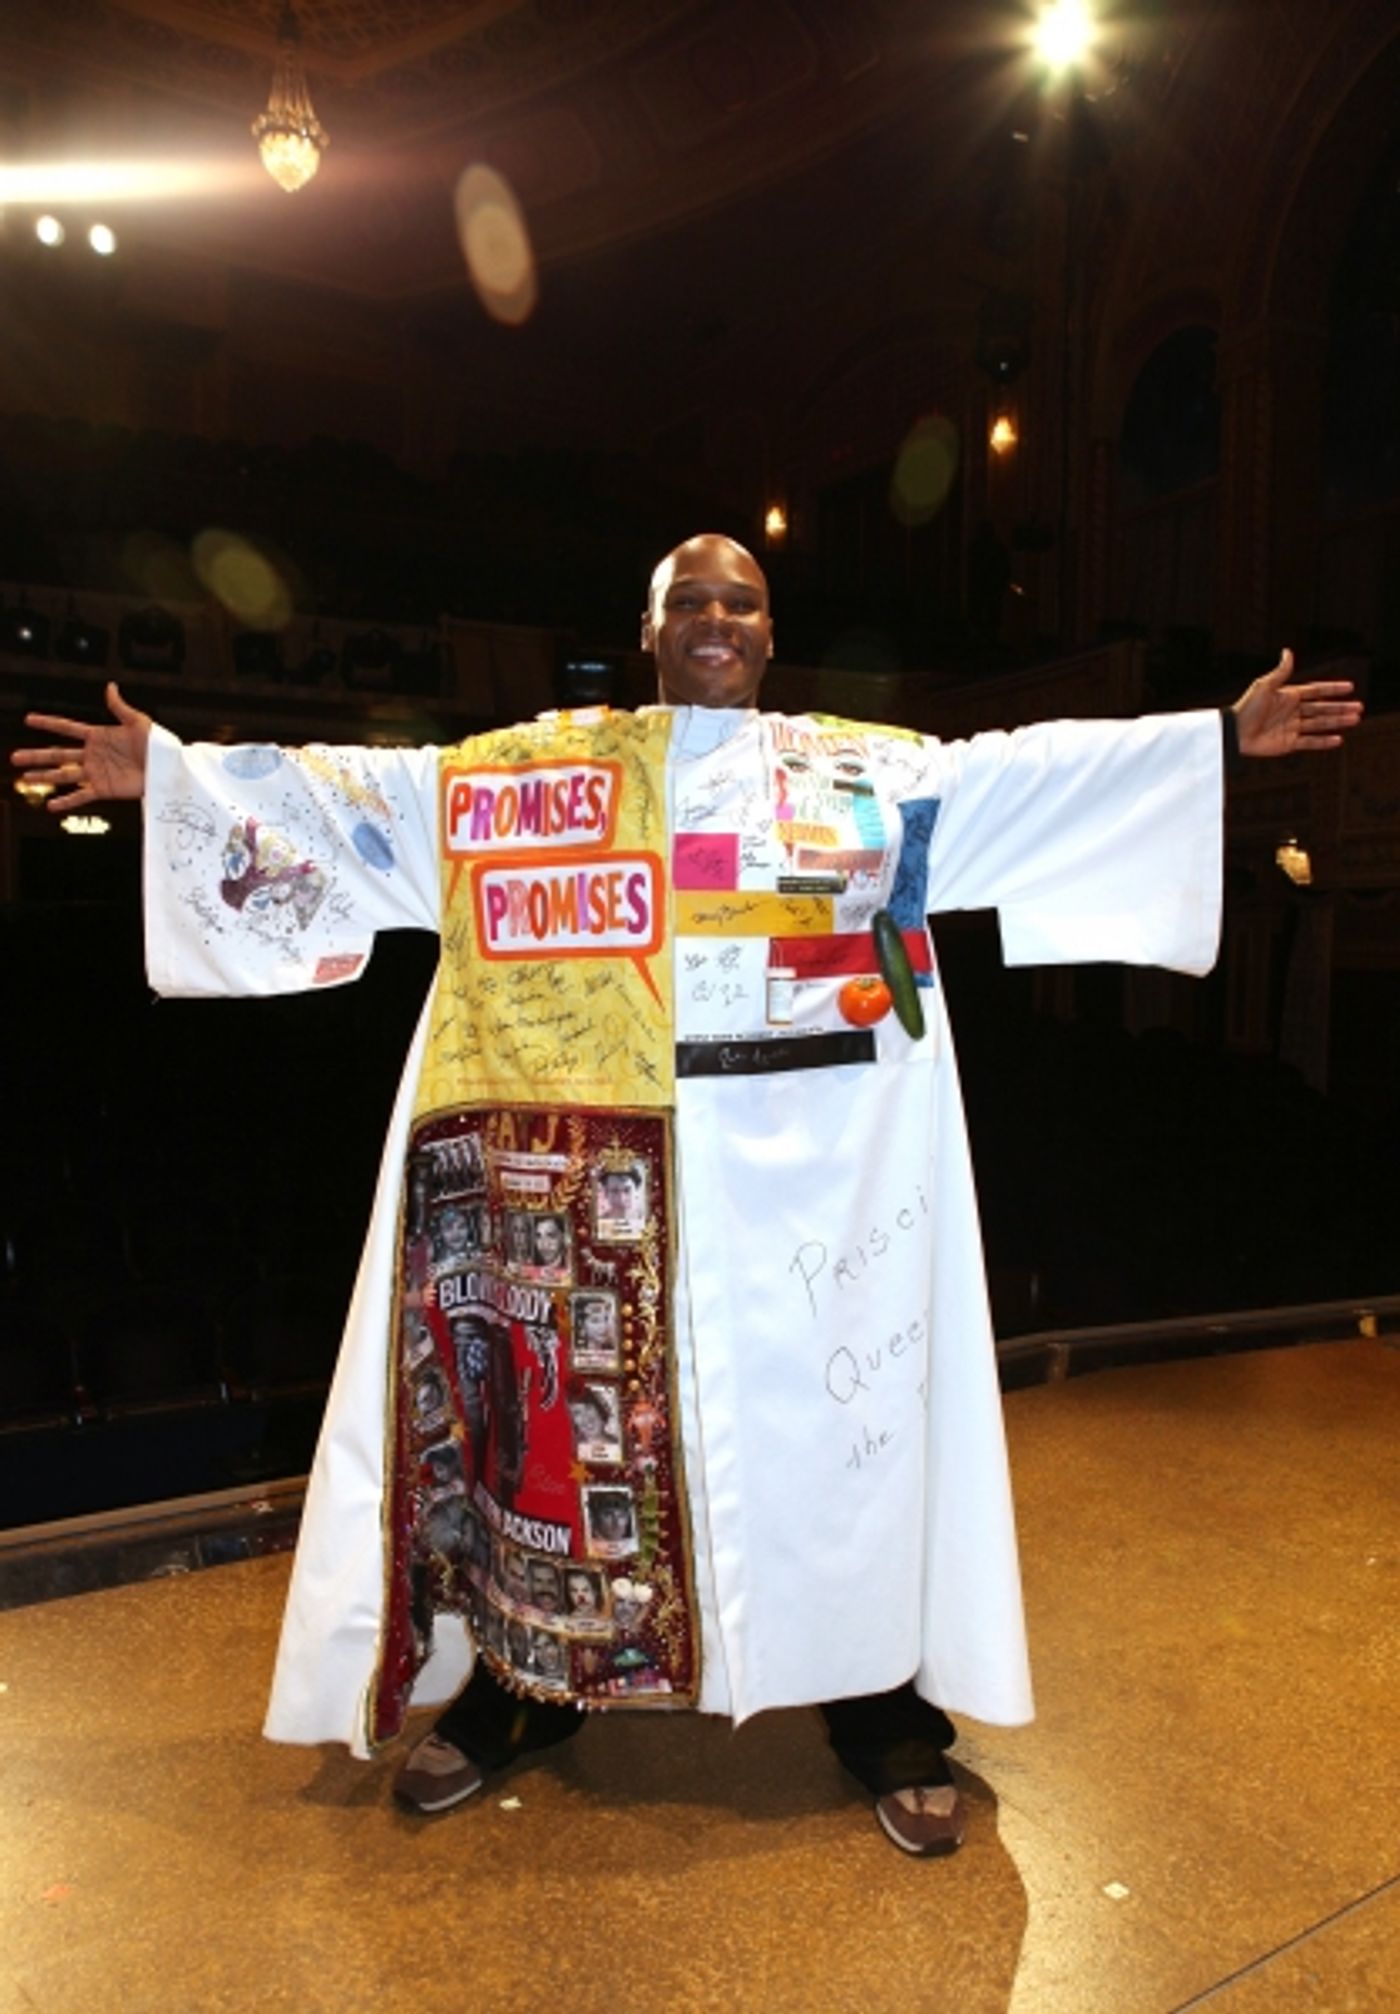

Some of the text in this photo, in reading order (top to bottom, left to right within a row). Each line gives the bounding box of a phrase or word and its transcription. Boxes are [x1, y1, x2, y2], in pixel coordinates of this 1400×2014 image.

[449, 773, 607, 841] PROMISES,
[486, 872, 649, 942] PROMISES
[825, 1311, 929, 1405] Quee
